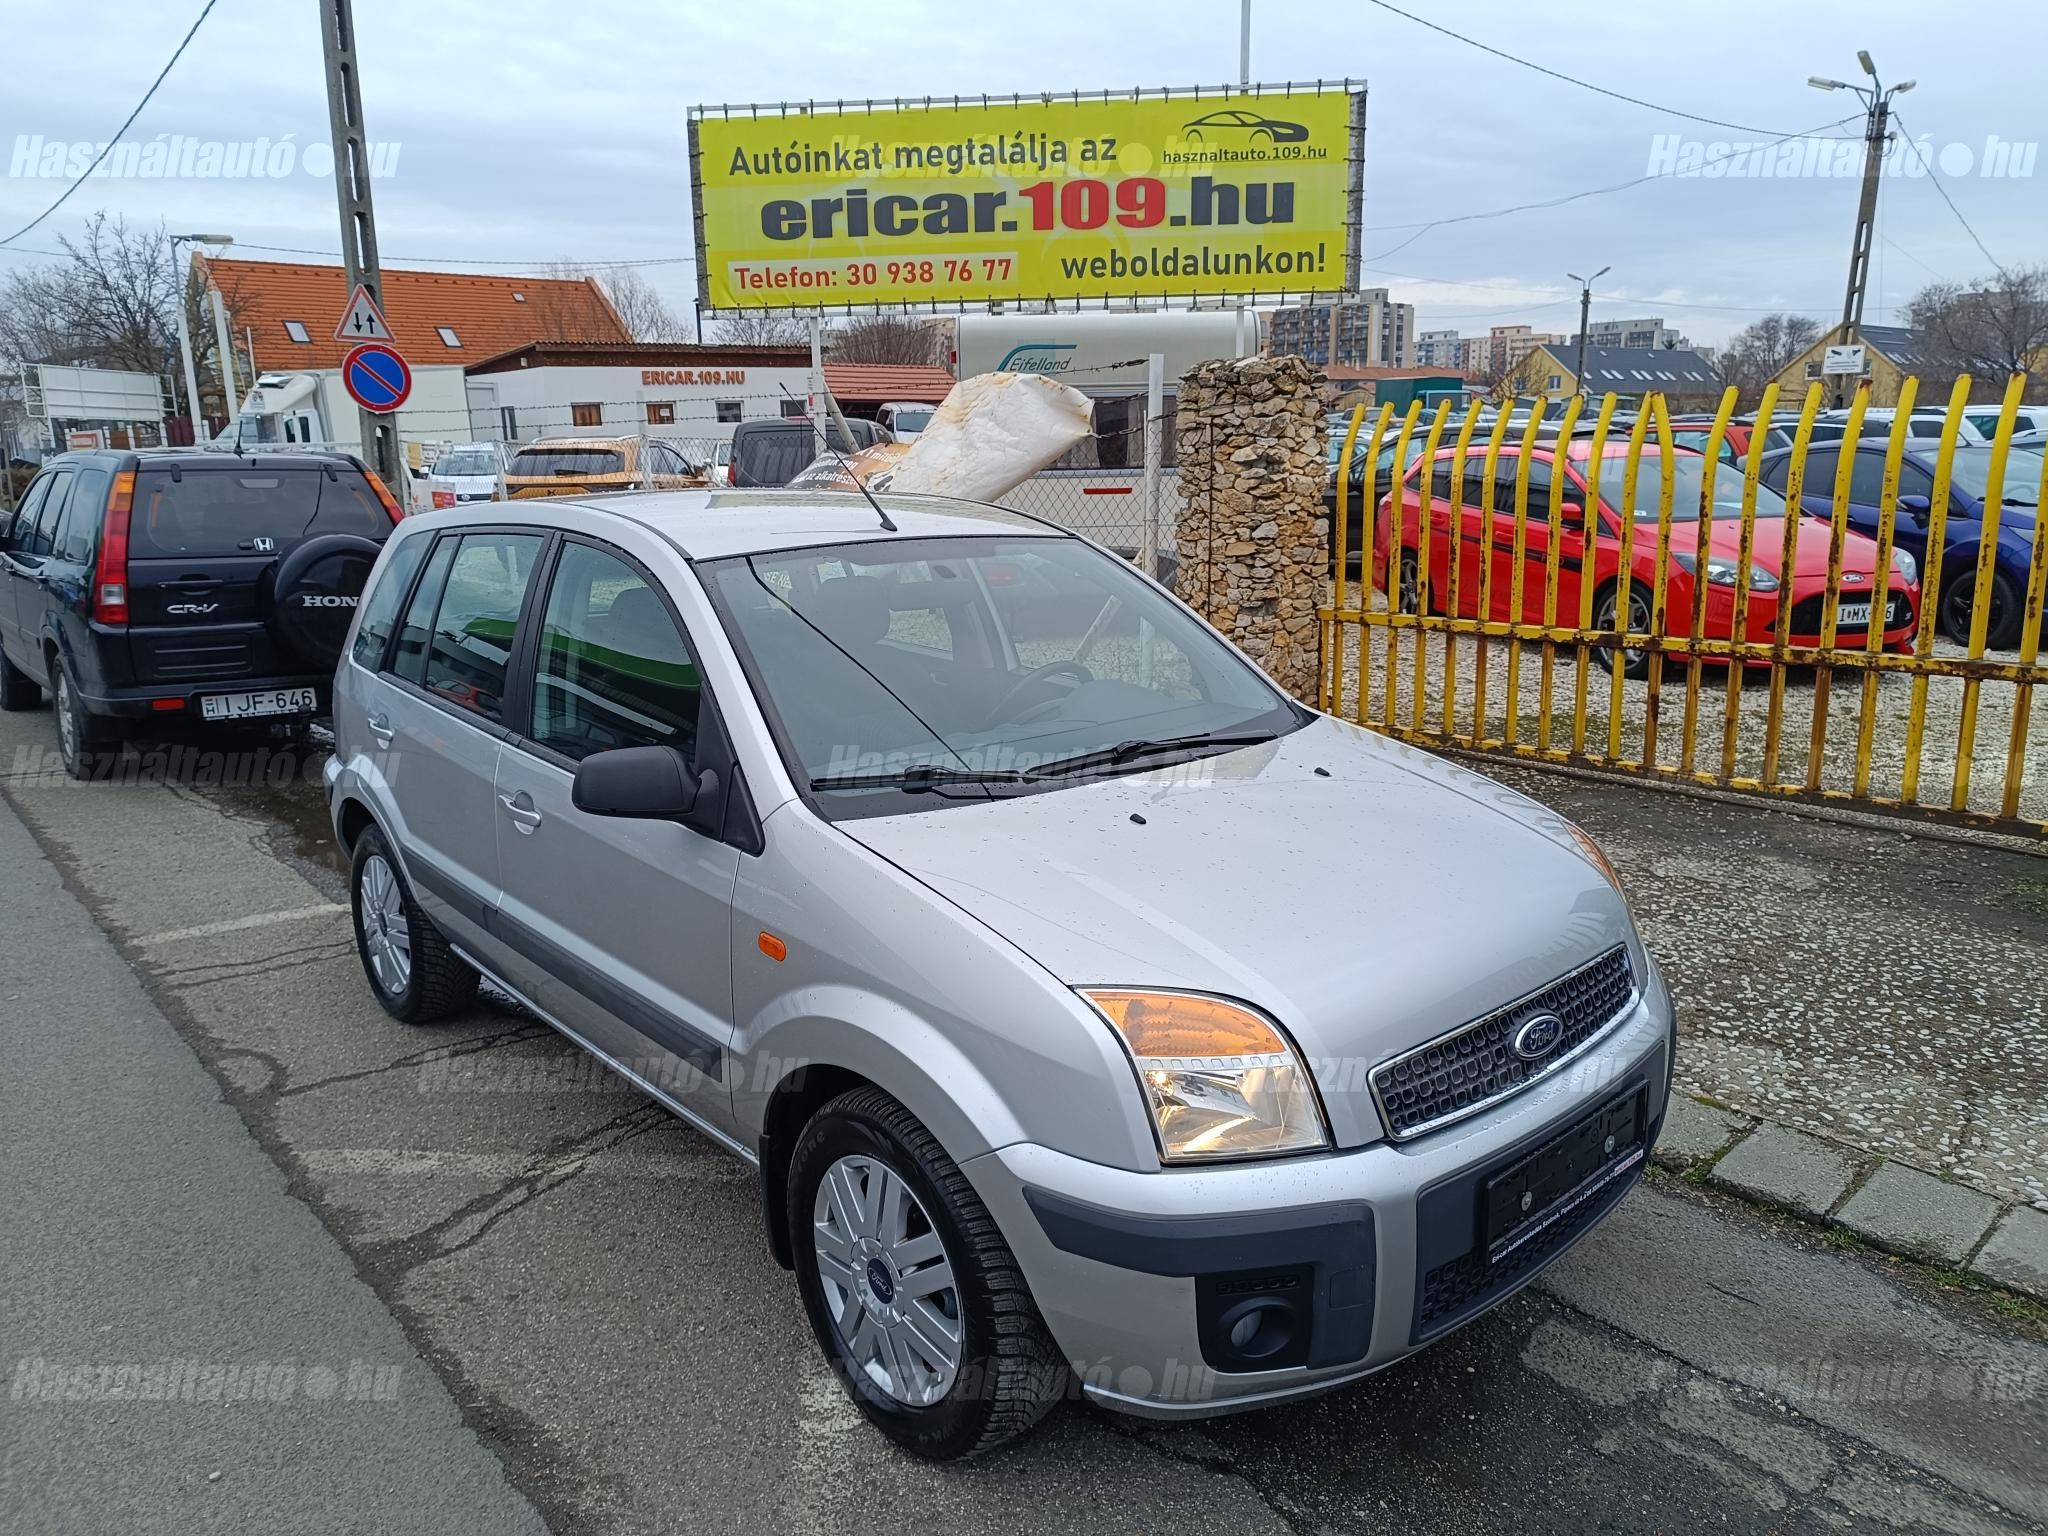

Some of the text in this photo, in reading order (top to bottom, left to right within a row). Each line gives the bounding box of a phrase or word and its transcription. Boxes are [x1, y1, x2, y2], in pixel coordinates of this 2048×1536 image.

[729, 130, 1117, 176] Autóinkat megtalálja az
[1162, 146, 1328, 163] hasznaltauto.109.hu
[761, 175, 1294, 241] ericar.109.hu
[1061, 242, 1325, 279] weboldalunkon!
[734, 258, 1012, 290] Telefon: 30 938 76 77
[1009, 357, 1072, 372] Eifelland
[641, 371, 745, 386] ERICAR.109.HU
[166, 603, 219, 614] CR-V
[303, 596, 359, 607] HON
[1852, 605, 1892, 621] MX-6
[1529, 1021, 1555, 1050] Ford
